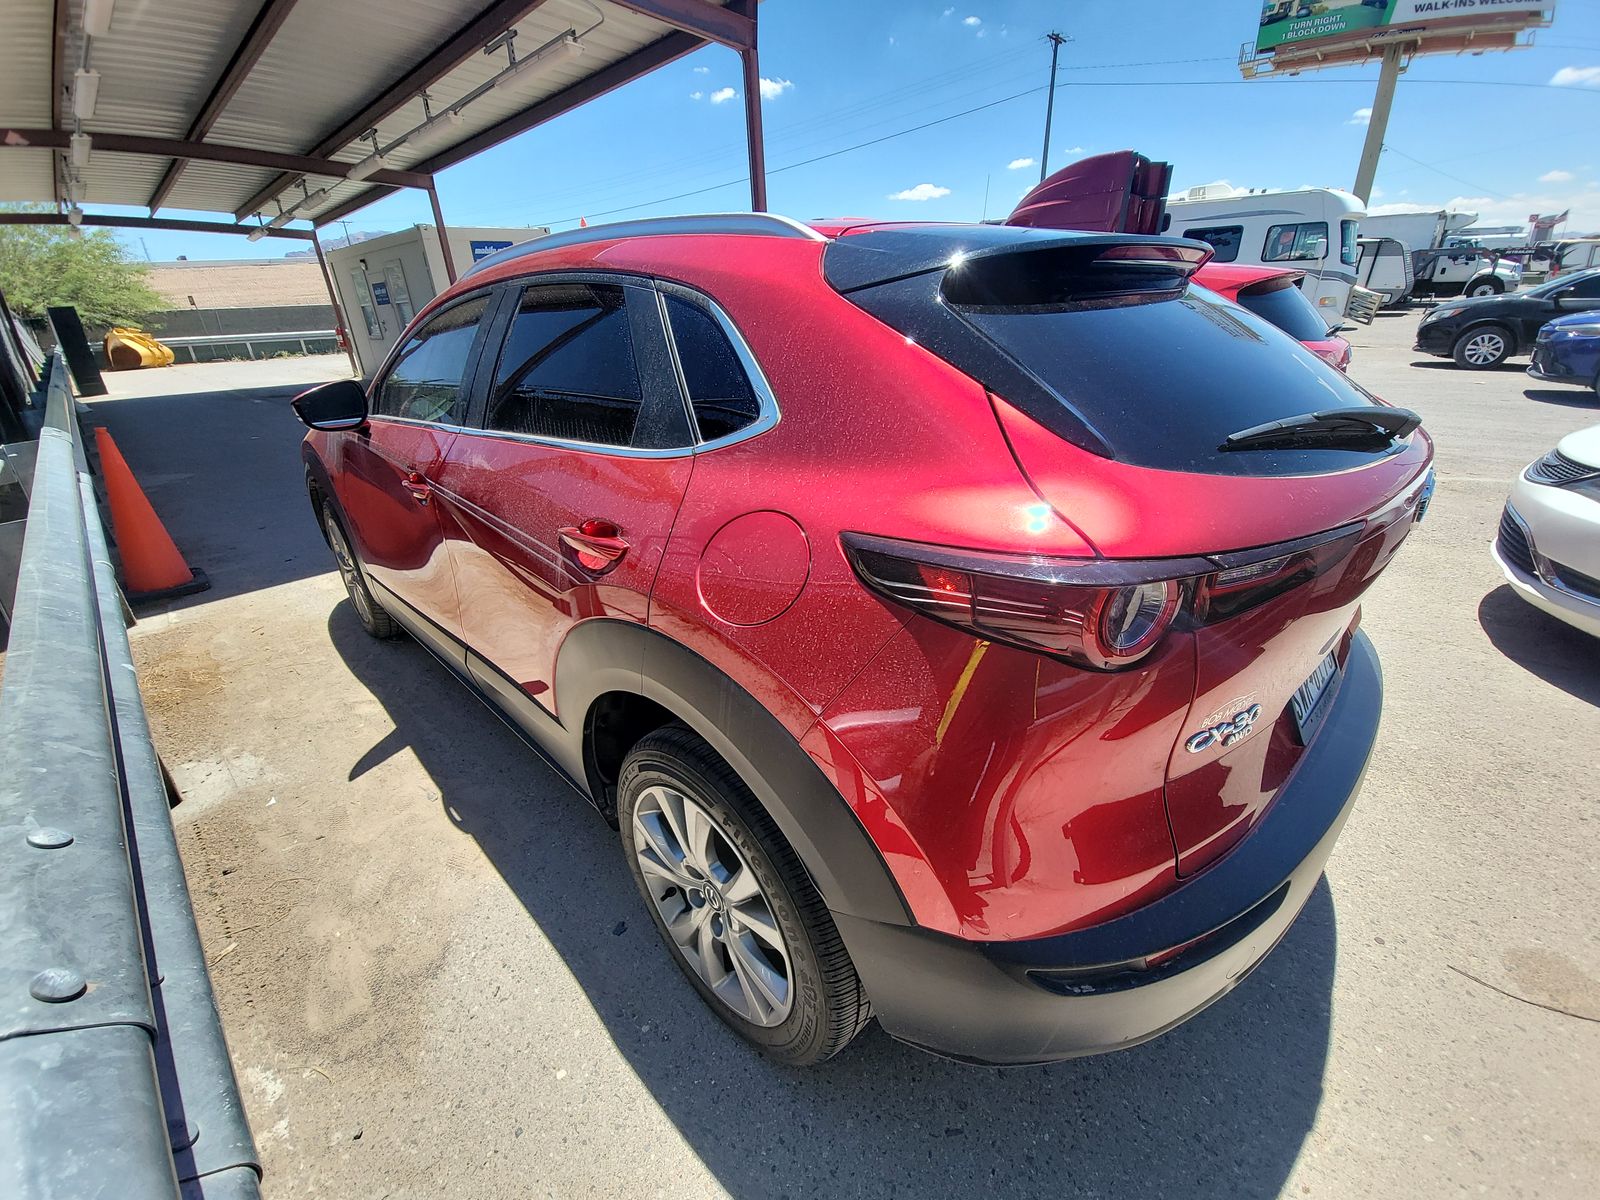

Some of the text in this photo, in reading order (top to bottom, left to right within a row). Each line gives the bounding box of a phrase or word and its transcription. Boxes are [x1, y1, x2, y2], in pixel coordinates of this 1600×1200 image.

[1414, 0, 1475, 13] WALK-INS
[1287, 27, 1319, 39] BLOCK
[1319, 22, 1347, 32] DOWN
[1289, 14, 1343, 31] TURN RIGHT
[1201, 695, 1256, 728] BOB MOORE
[1184, 703, 1263, 754] CX-30
[1223, 724, 1253, 747] AWD
